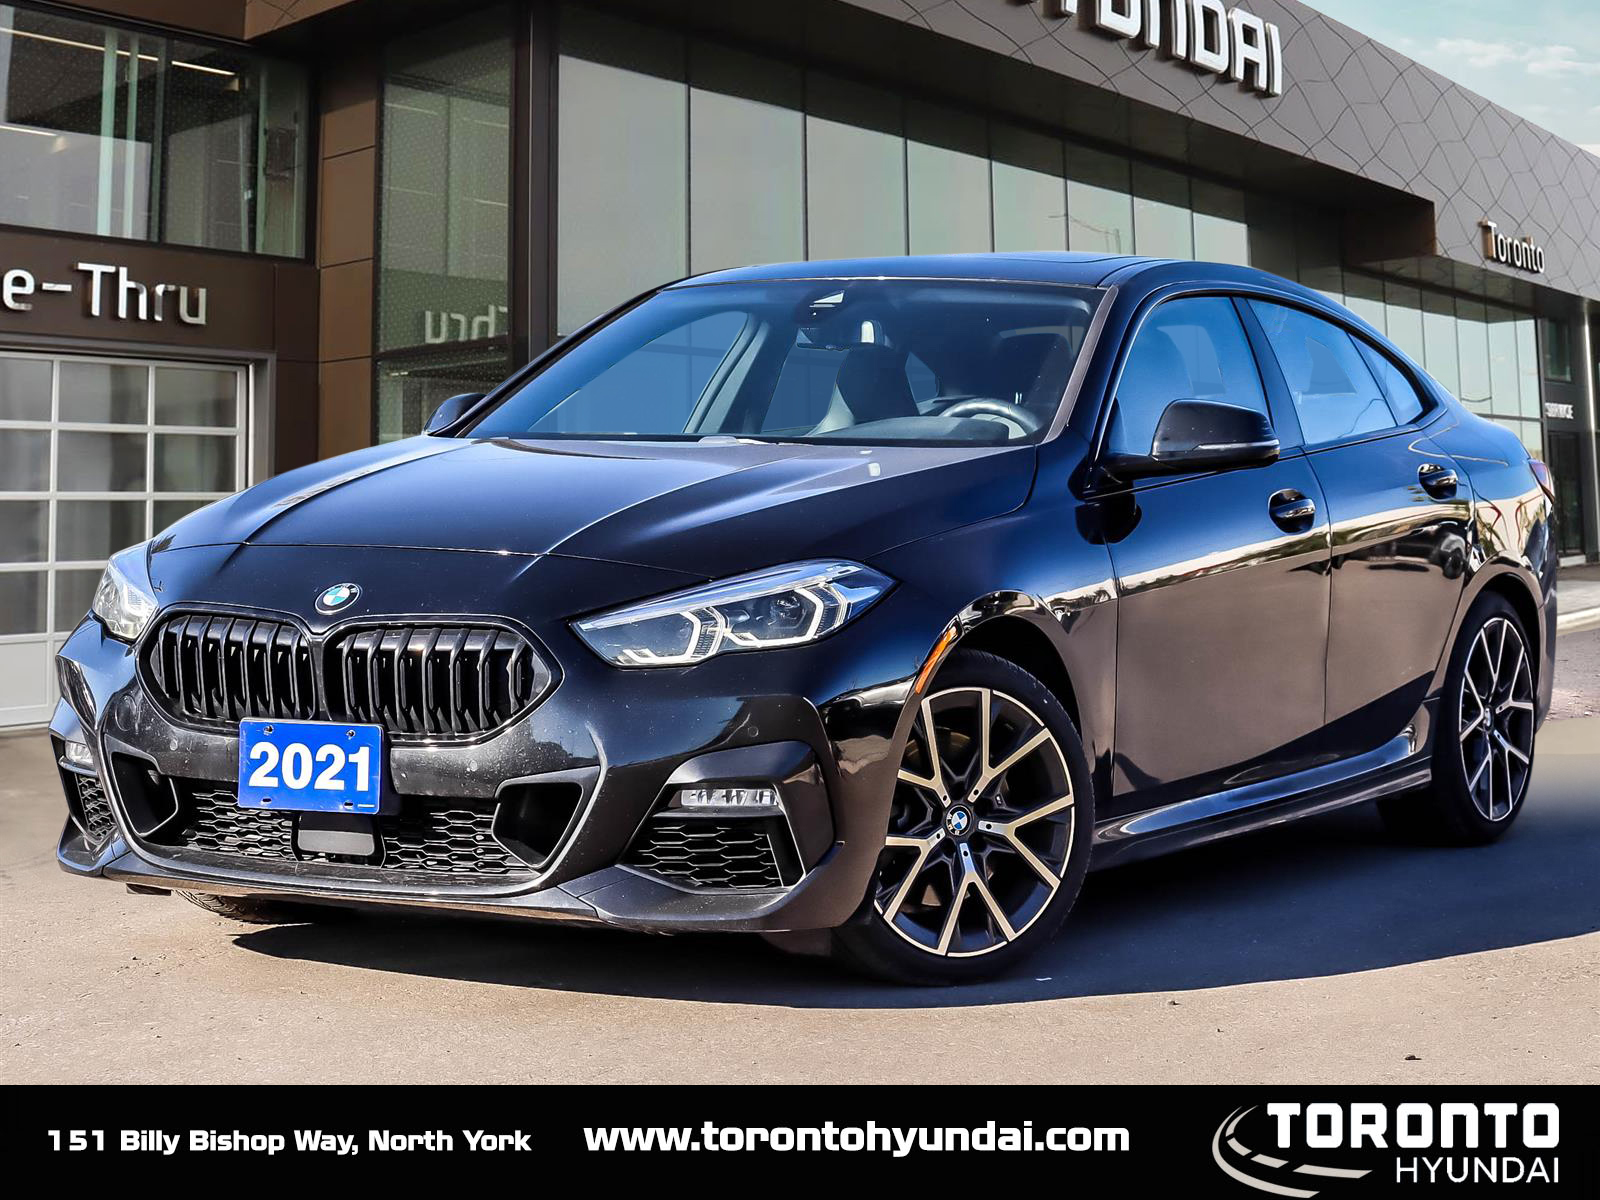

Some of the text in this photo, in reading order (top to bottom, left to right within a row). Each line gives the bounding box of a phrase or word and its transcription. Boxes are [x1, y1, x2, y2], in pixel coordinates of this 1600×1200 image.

[1058, 0, 1283, 97] NDAI
[1481, 219, 1545, 274] Toronto
[2, 261, 207, 326] e-Thru
[248, 741, 370, 792] 2021
